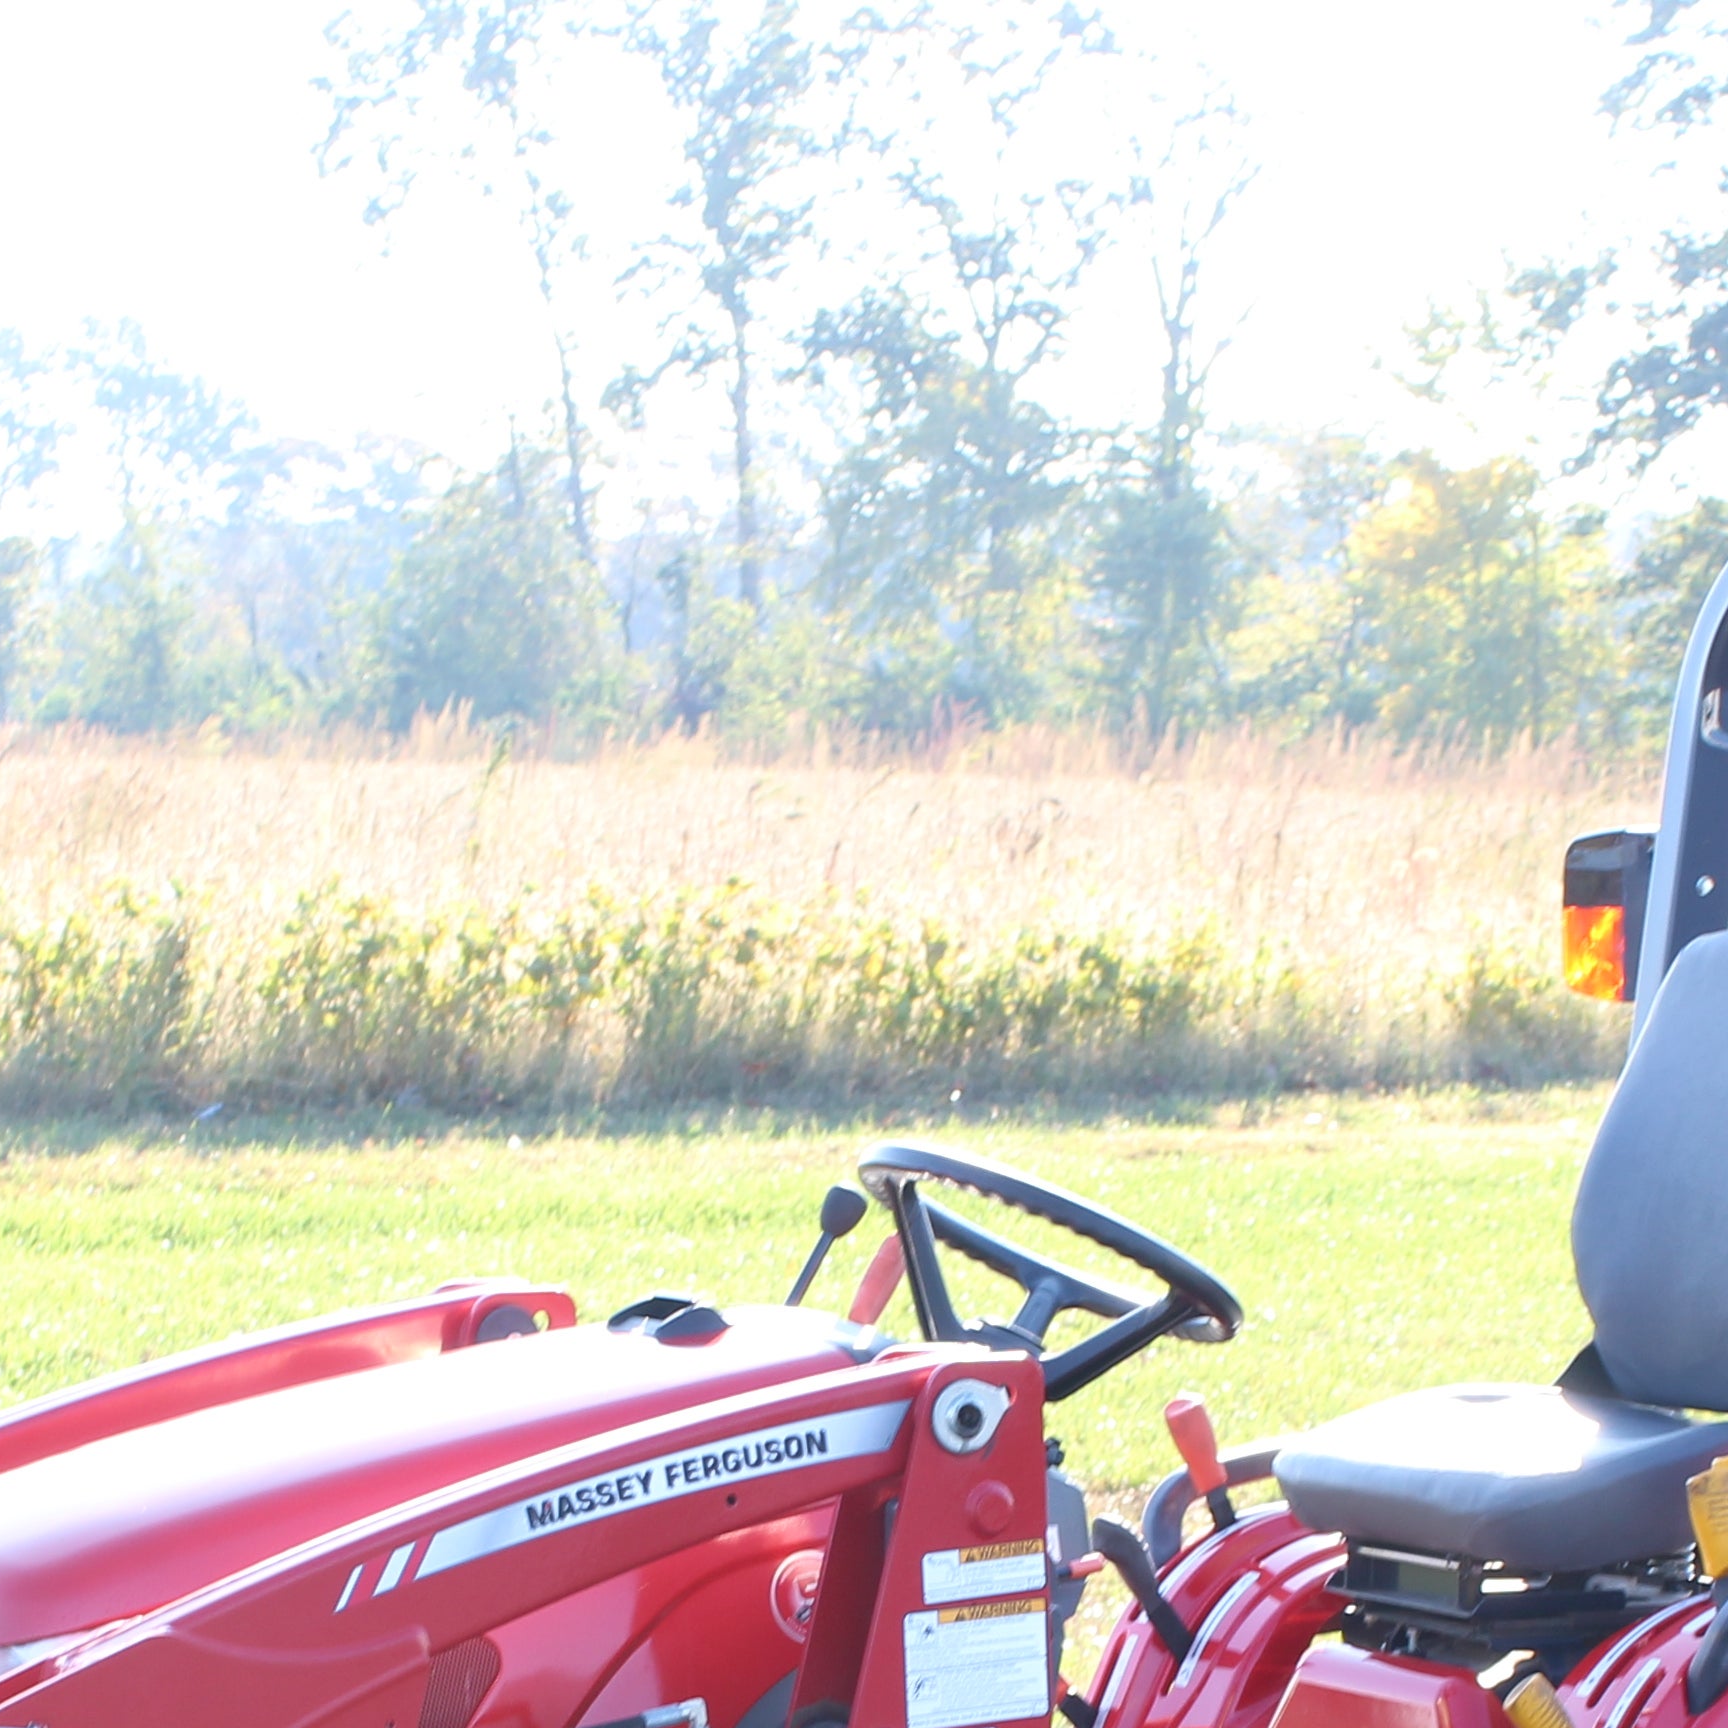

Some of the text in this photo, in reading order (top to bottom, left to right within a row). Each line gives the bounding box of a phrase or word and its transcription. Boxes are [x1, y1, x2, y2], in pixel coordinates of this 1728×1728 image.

[525, 1428, 829, 1531] MASSEY FERGUSON
[977, 1540, 1042, 1561] WARNING
[969, 1601, 1032, 1620] WARNING
